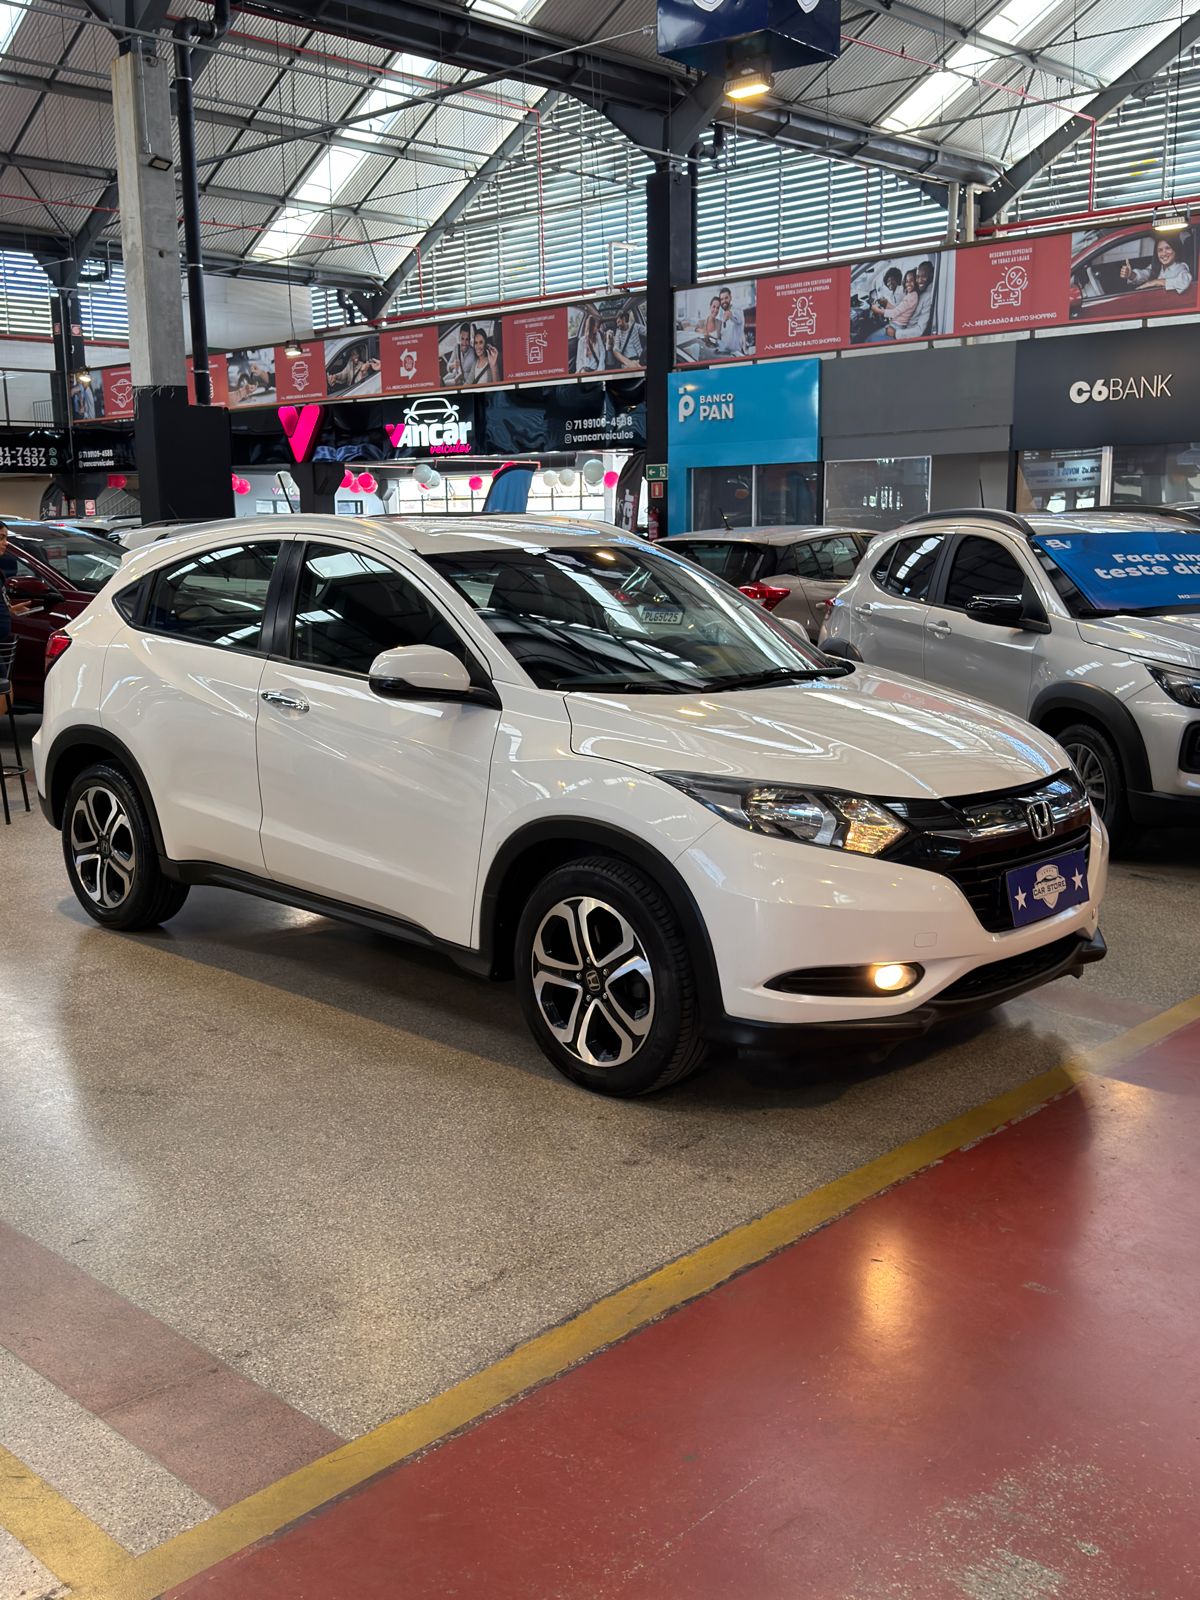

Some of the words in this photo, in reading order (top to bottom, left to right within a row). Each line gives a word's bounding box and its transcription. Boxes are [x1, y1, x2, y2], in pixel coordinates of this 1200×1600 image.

[700, 392, 734, 403] BANCO
[700, 404, 734, 420] PAN
[573, 419, 582, 429] 71
[572, 429, 634, 442] vancarveiculos
[1112, 553, 1171, 565] Faça
[1094, 564, 1169, 579] teste
[1034, 886, 1045, 896] CAR
[1047, 880, 1065, 891] STORE
